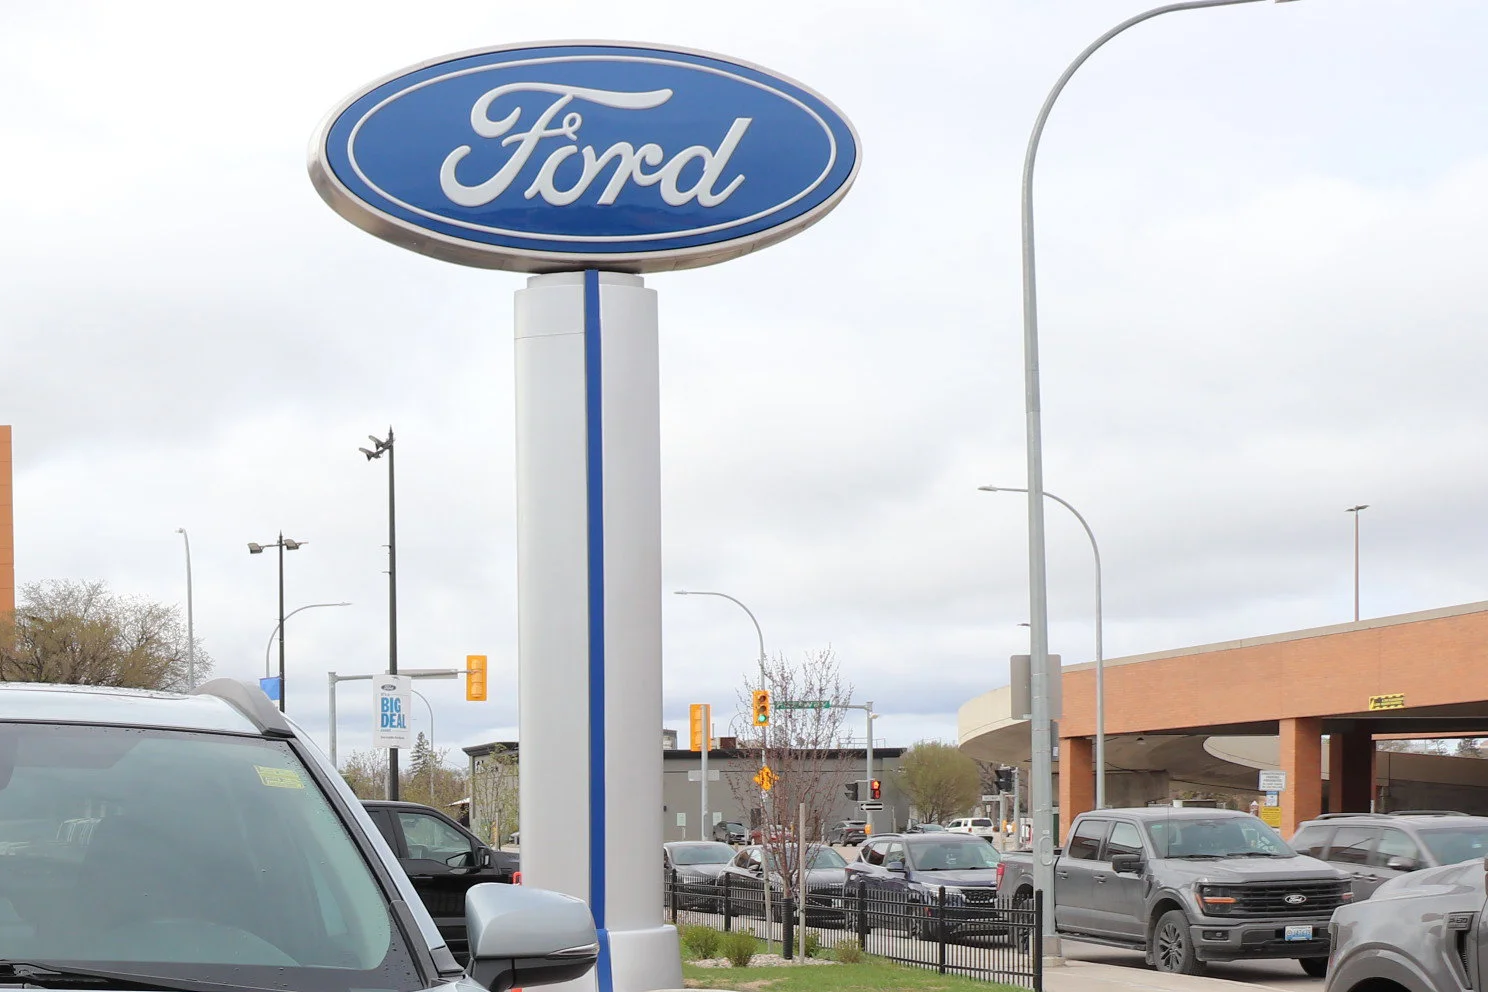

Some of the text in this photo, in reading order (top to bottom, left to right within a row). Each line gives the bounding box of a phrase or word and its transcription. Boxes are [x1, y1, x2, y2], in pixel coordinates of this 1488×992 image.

[439, 81, 753, 208] Ford
[381, 697, 401, 713] BIG
[381, 713, 407, 729] DEAL
